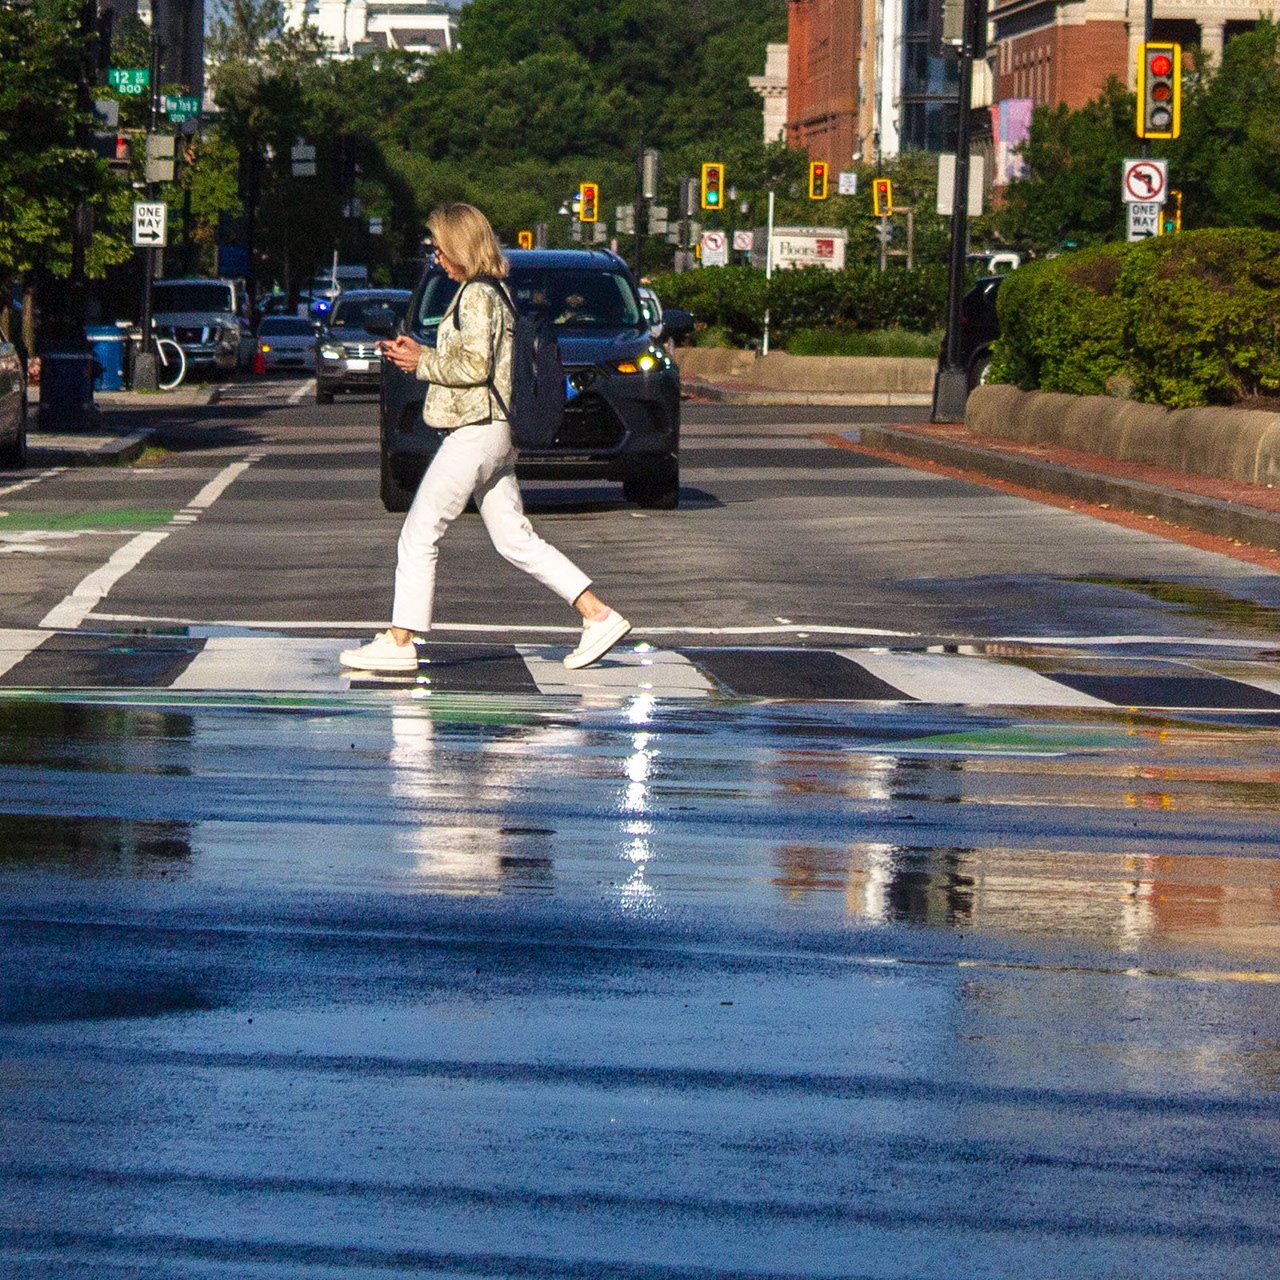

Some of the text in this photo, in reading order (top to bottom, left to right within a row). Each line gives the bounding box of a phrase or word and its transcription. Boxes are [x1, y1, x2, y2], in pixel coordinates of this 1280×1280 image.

[114, 71, 129, 84] 12
[119, 84, 142, 93] 800
[138, 207, 161, 217] ONE
[1132, 204, 1156, 215] ONE
[137, 219, 161, 228] WAY
[1132, 216, 1156, 227] WAY
